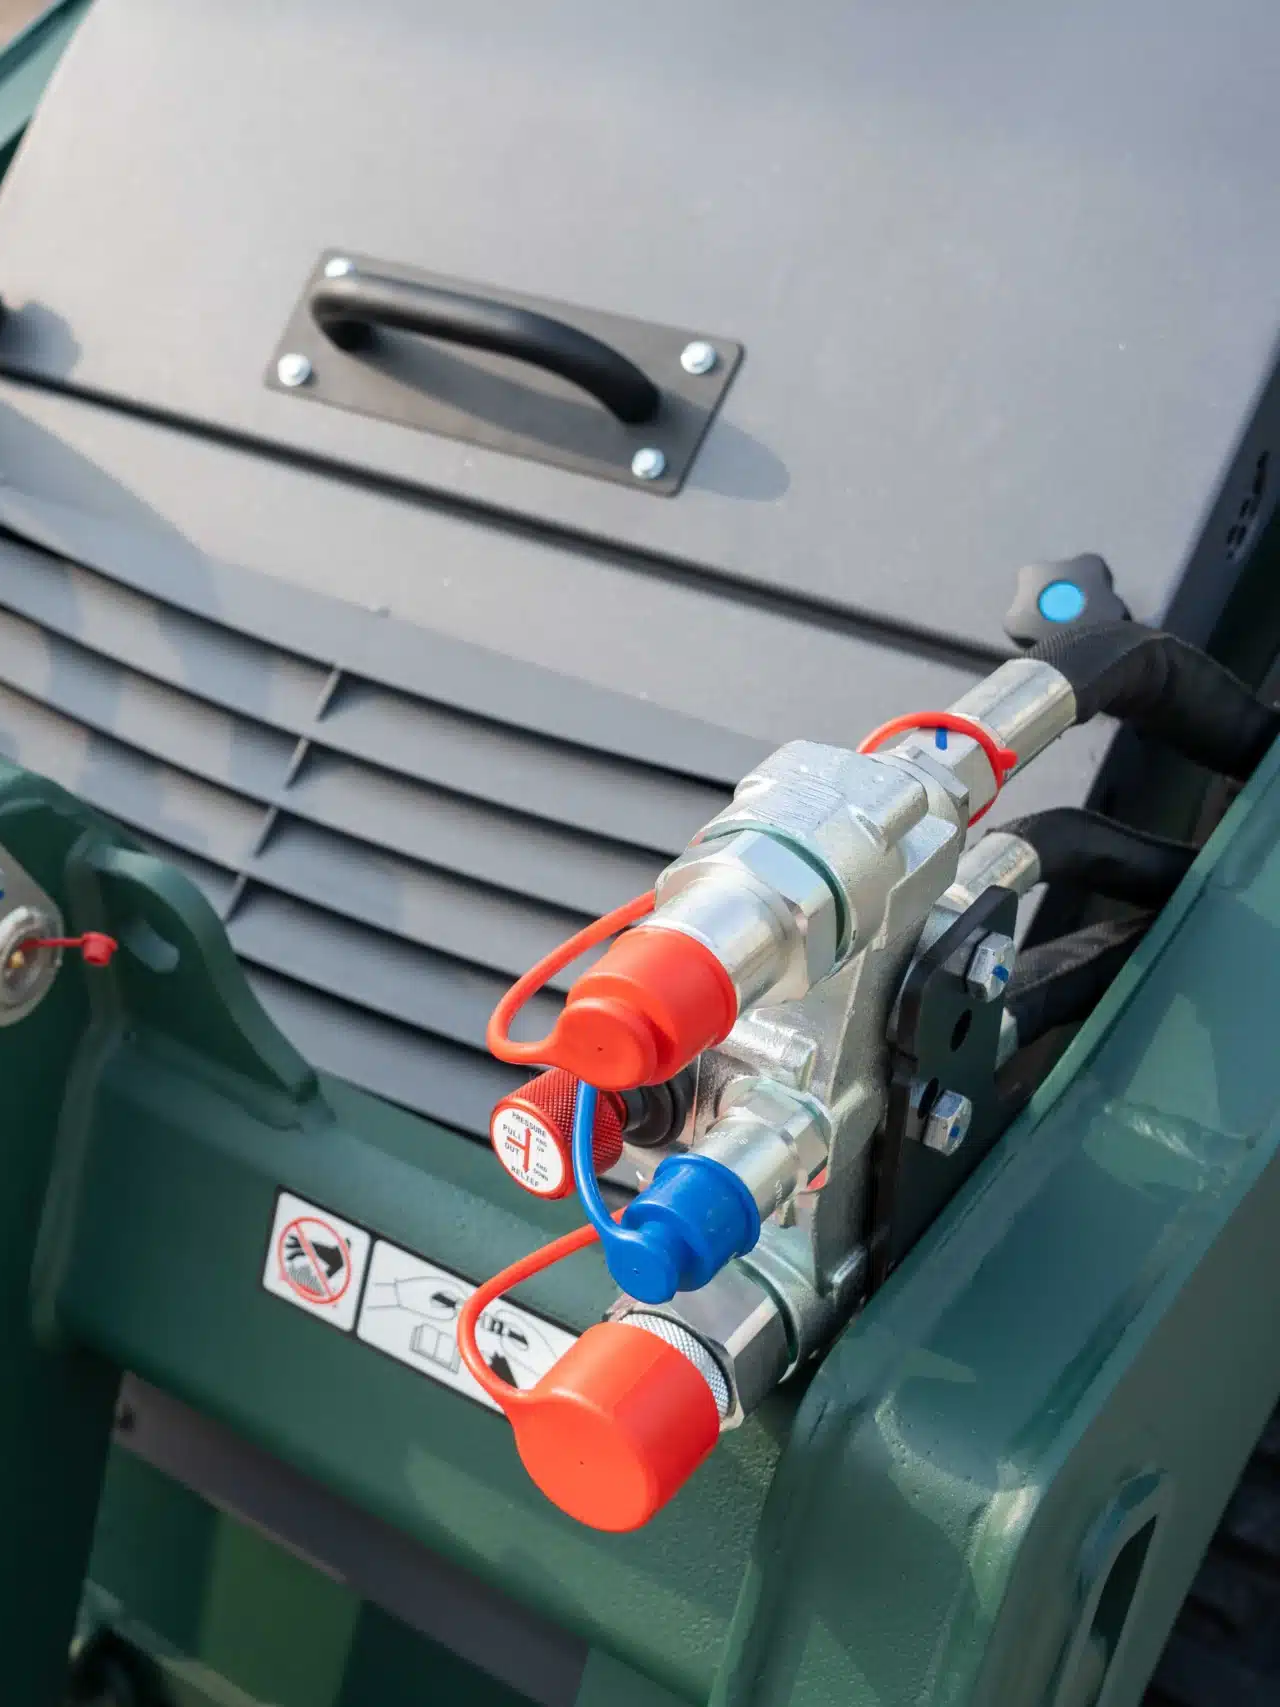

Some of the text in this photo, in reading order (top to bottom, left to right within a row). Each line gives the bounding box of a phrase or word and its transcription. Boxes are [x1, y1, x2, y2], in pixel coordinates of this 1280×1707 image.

[503, 1124, 522, 1141] PULL
[512, 1111, 547, 1137] PRESSURE
[504, 1142, 520, 1155] OUT
[511, 1165, 539, 1186] RELIEF
